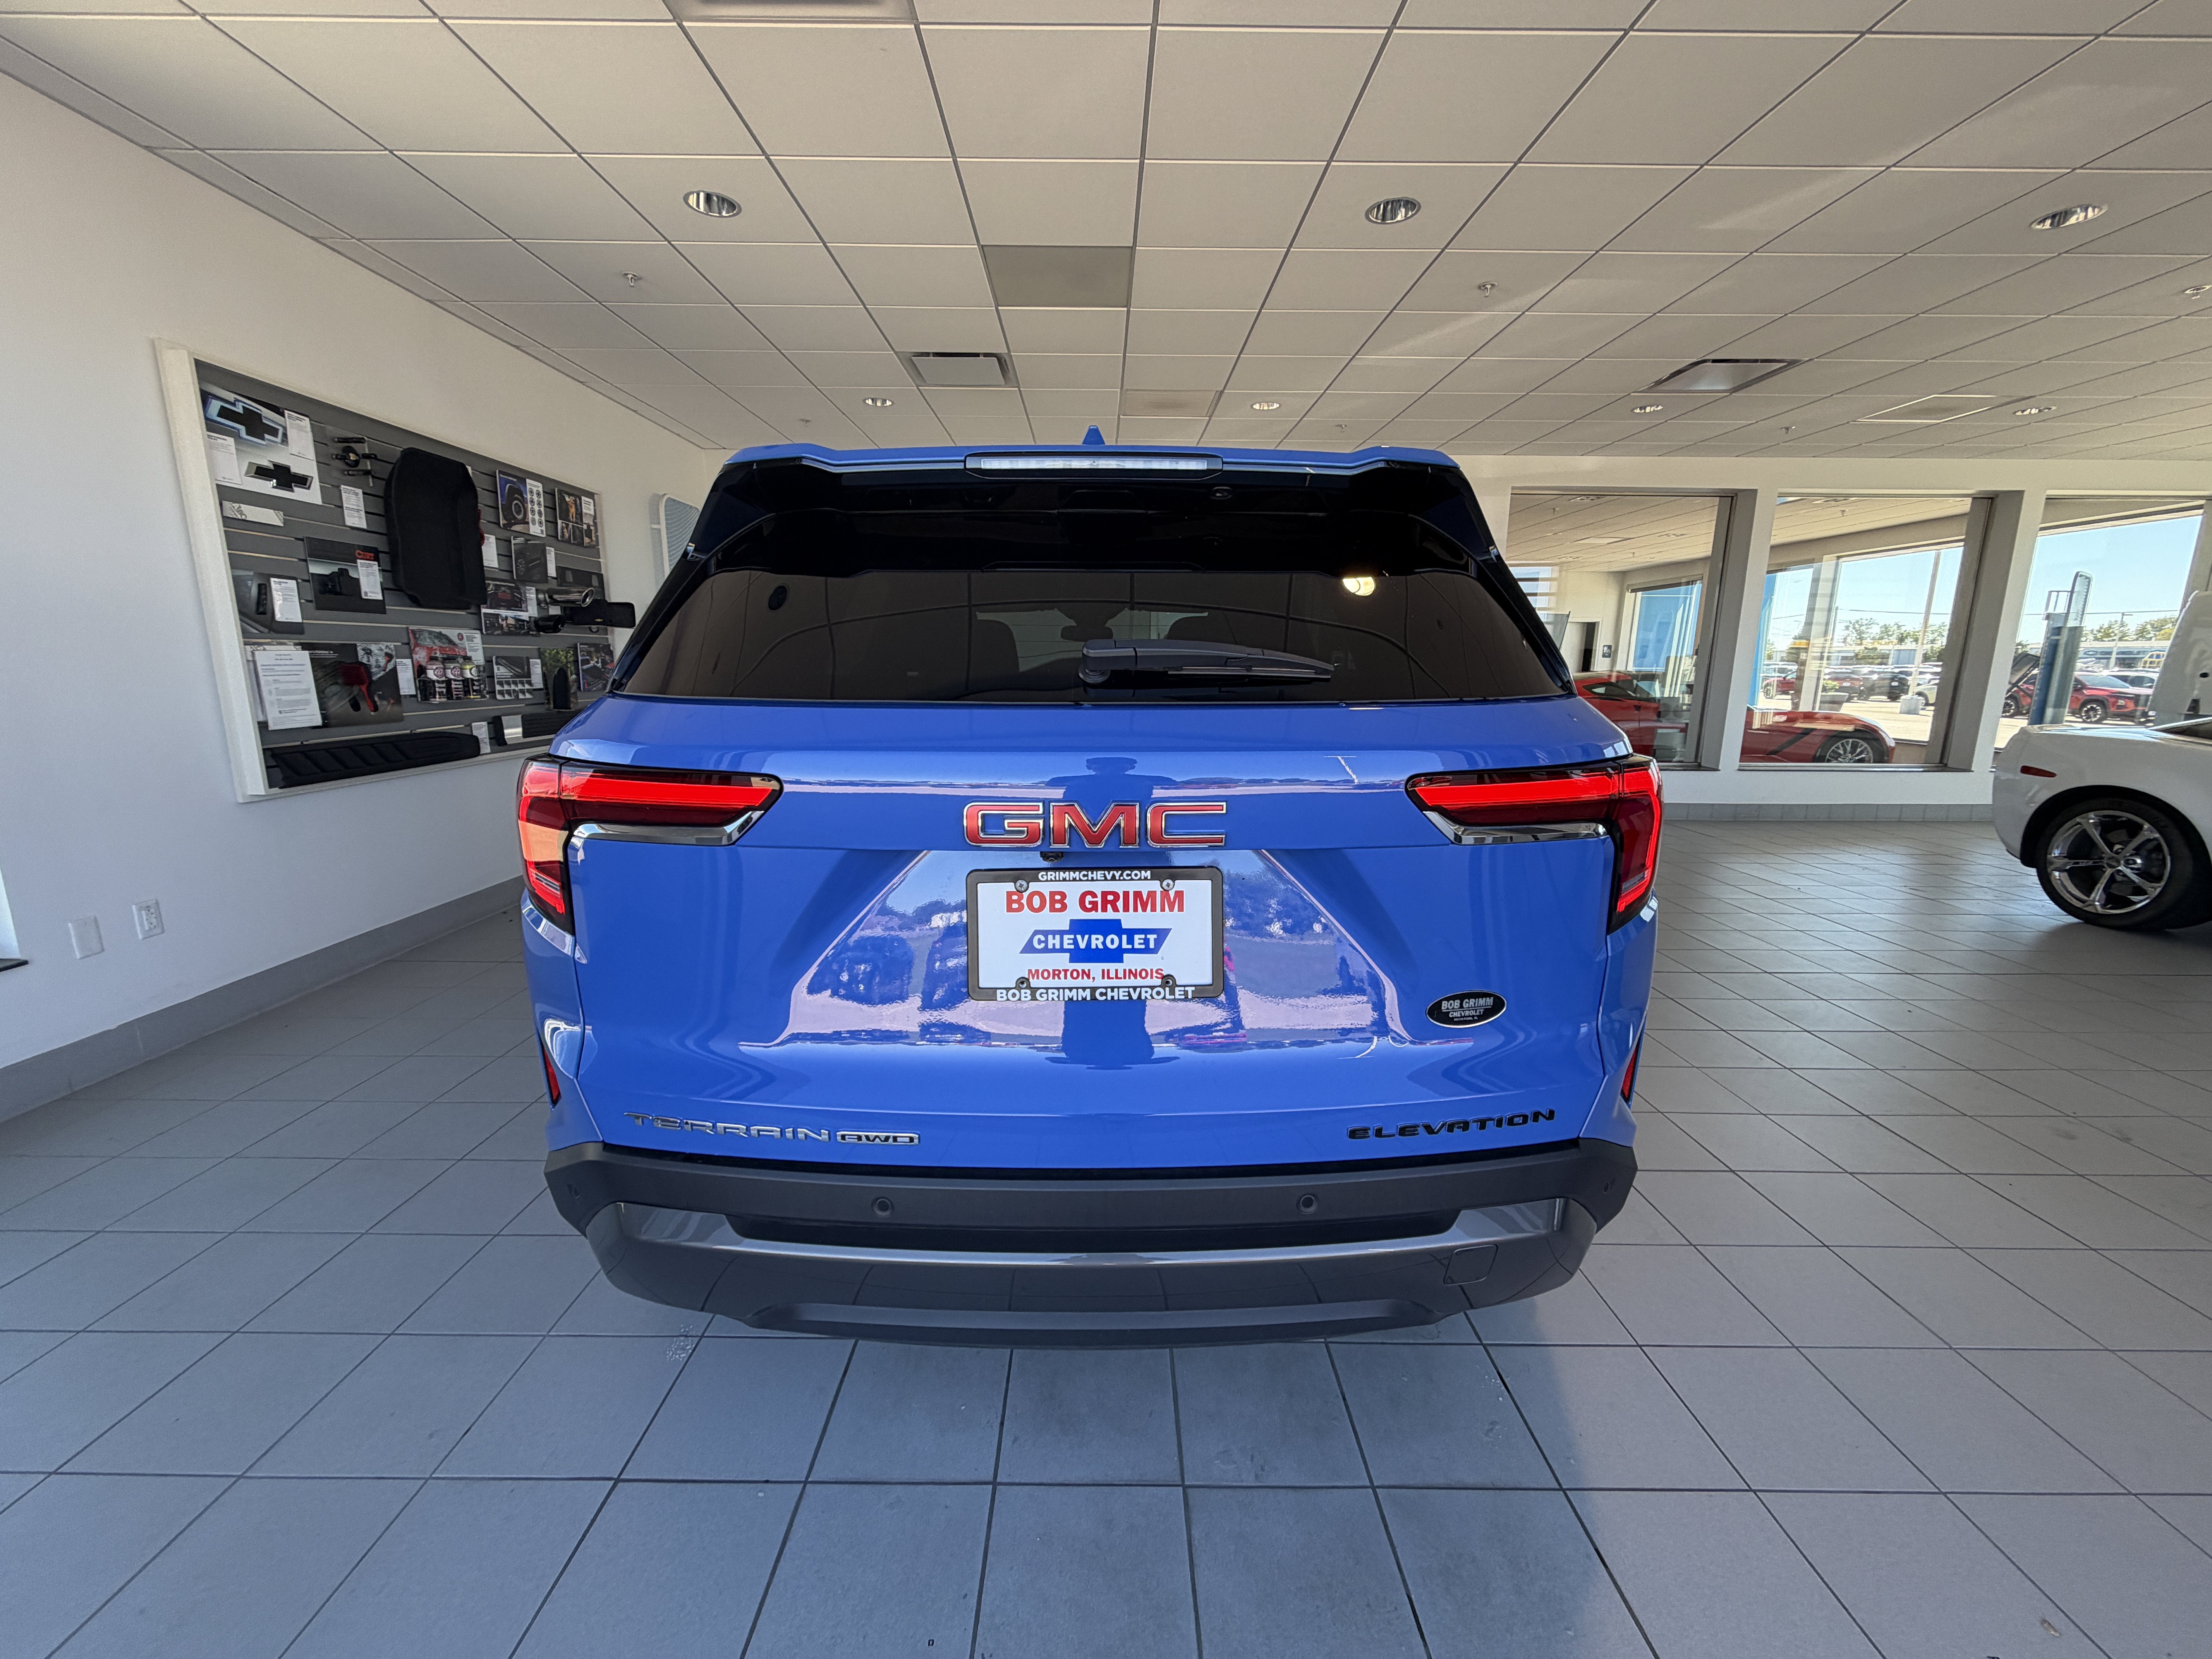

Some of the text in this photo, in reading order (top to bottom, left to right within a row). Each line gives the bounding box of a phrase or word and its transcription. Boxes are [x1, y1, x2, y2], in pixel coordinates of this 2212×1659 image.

[964, 801, 1226, 848] GMC
[1038, 871, 1151, 881] GRIMMCHEVY.COM
[1006, 890, 1185, 913] BOB GRIMM
[1032, 934, 1158, 949] CHEVROLET
[1027, 968, 1164, 982] MORTON, ILLINOIS
[996, 986, 1195, 1001] BOB GRIMM CHEVROLET
[1442, 997, 1494, 1010] BOB GRIMM
[1449, 1009, 1484, 1017] CHEVROLET
[623, 1112, 915, 1145] TERRAIN AWD
[1347, 1108, 1556, 1139] ELEVATION
